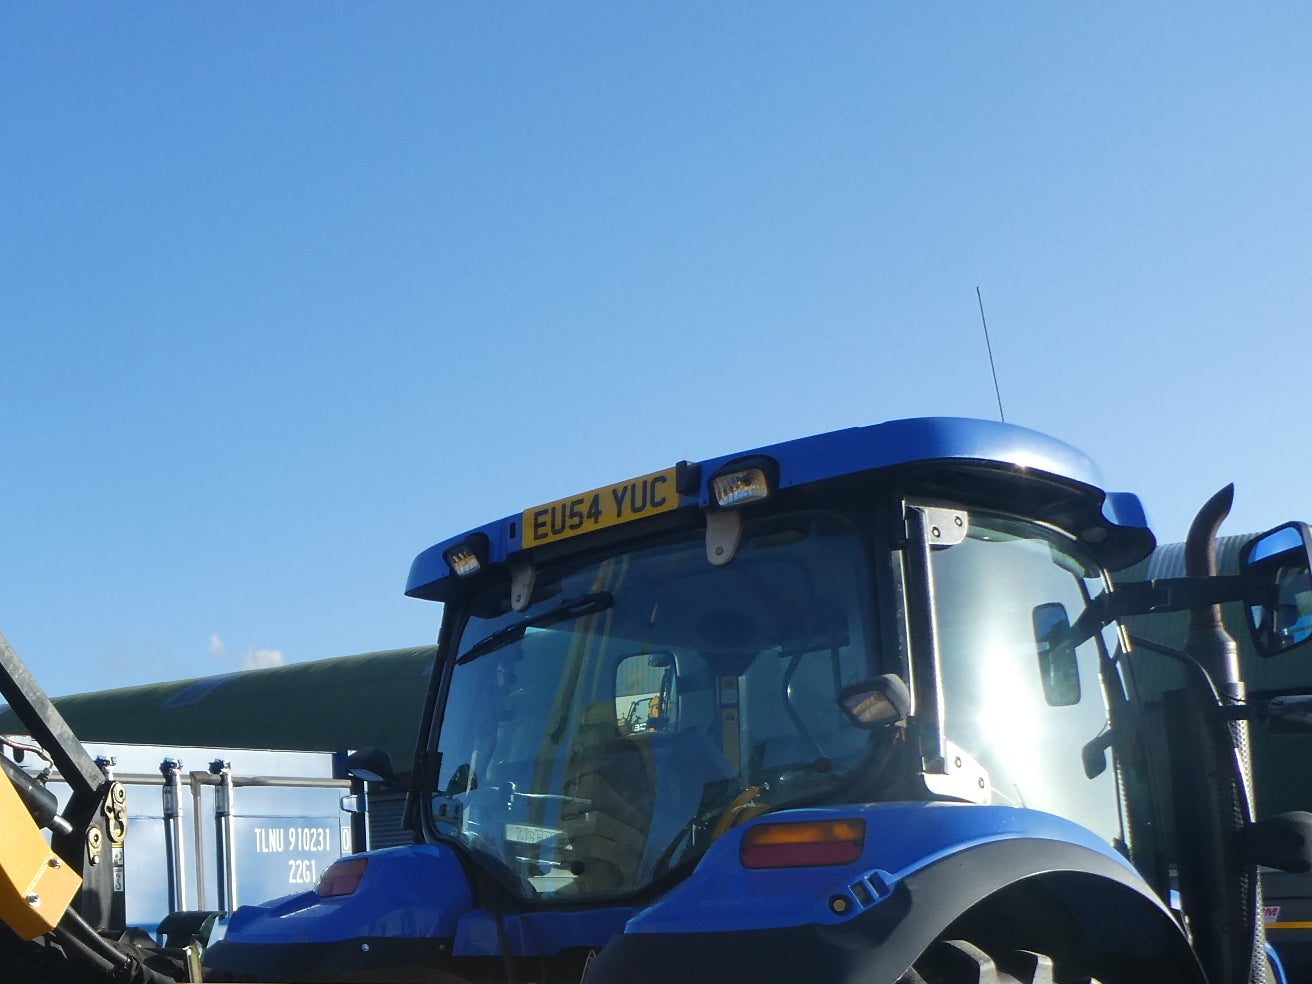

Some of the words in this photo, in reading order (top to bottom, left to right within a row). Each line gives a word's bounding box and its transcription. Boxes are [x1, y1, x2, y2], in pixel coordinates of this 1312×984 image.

[533, 493, 602, 541] EU54
[611, 475, 667, 518] YUC
[254, 828, 284, 852] TLNU
[288, 828, 331, 851] 910231
[342, 828, 350, 852] 0
[288, 860, 316, 883] 22G1
